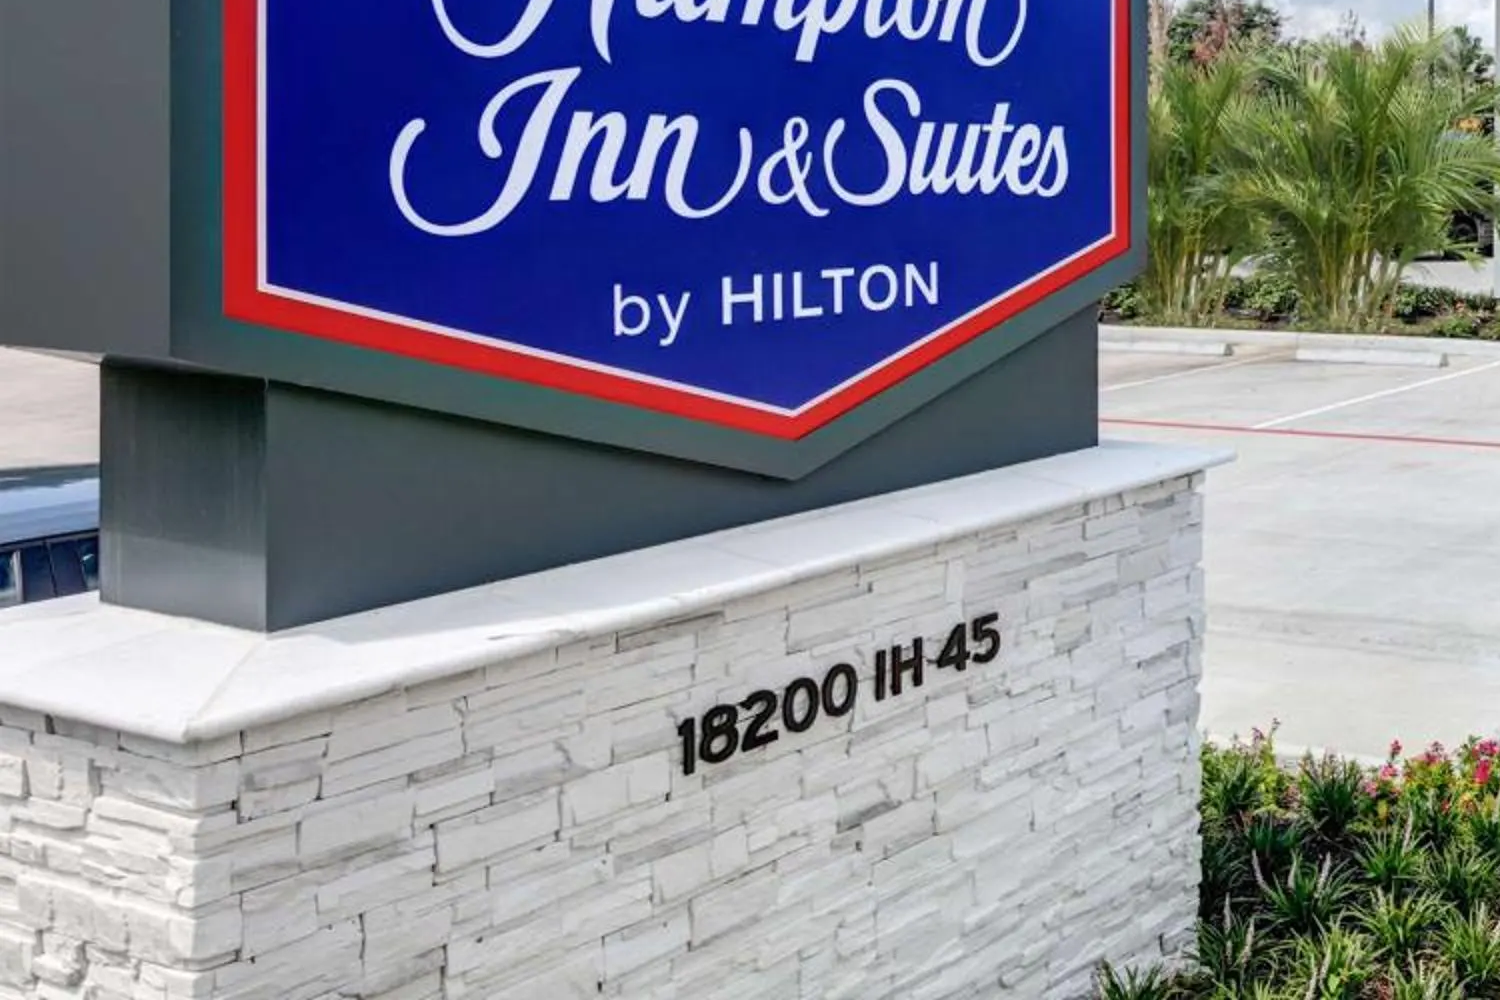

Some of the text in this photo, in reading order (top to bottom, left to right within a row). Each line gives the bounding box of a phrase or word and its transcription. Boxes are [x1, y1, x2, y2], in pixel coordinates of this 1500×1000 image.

[389, 67, 1069, 237] Inn & Suites
[612, 261, 940, 346] by HILTON
[677, 663, 858, 776] 18200
